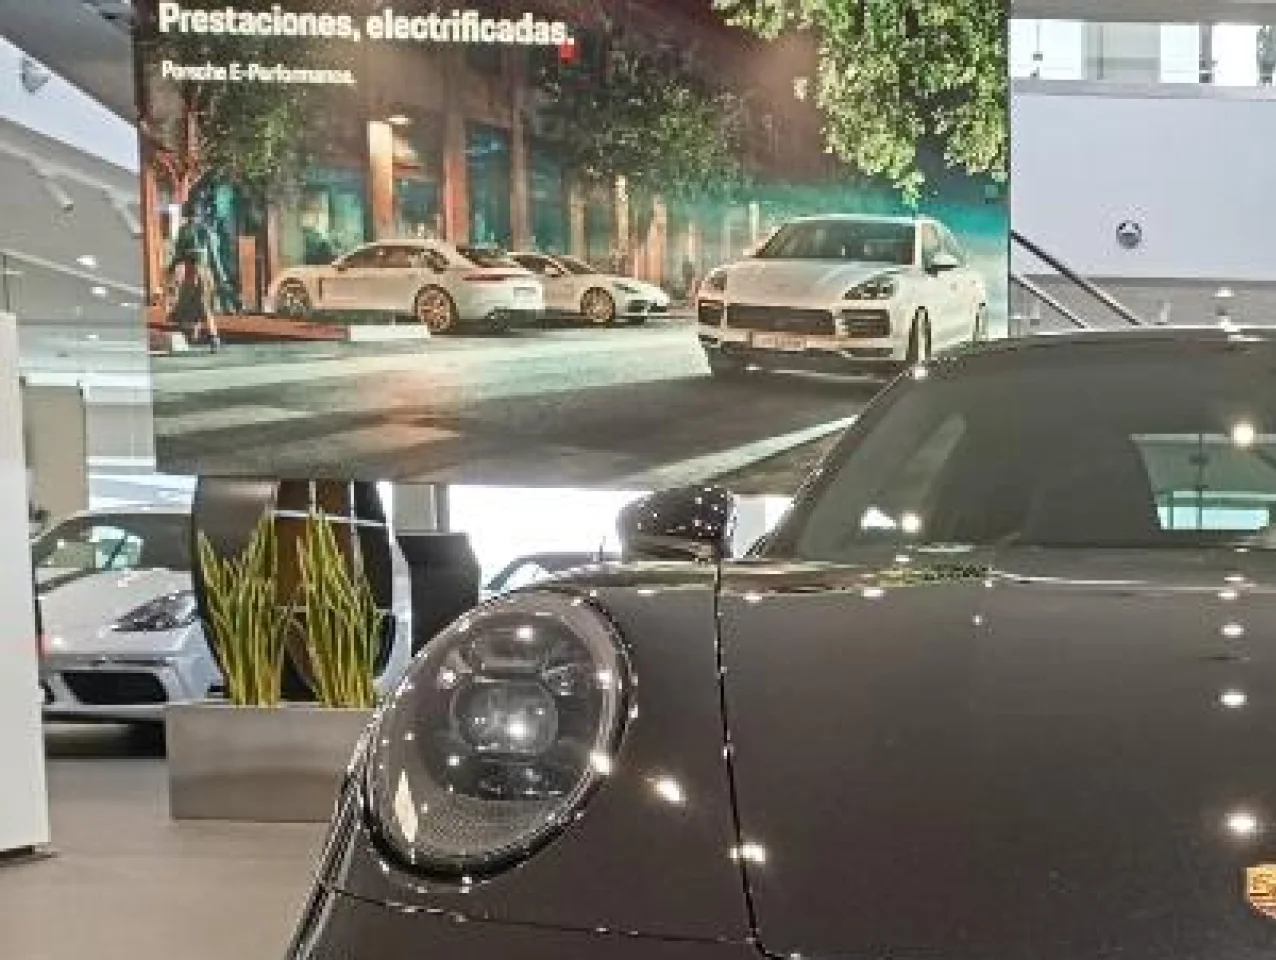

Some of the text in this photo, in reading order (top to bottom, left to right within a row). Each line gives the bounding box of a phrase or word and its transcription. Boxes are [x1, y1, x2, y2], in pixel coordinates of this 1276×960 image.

[159, 2, 575, 45] Prestaciones, electrificadas.
[162, 60, 227, 81] Porsche
